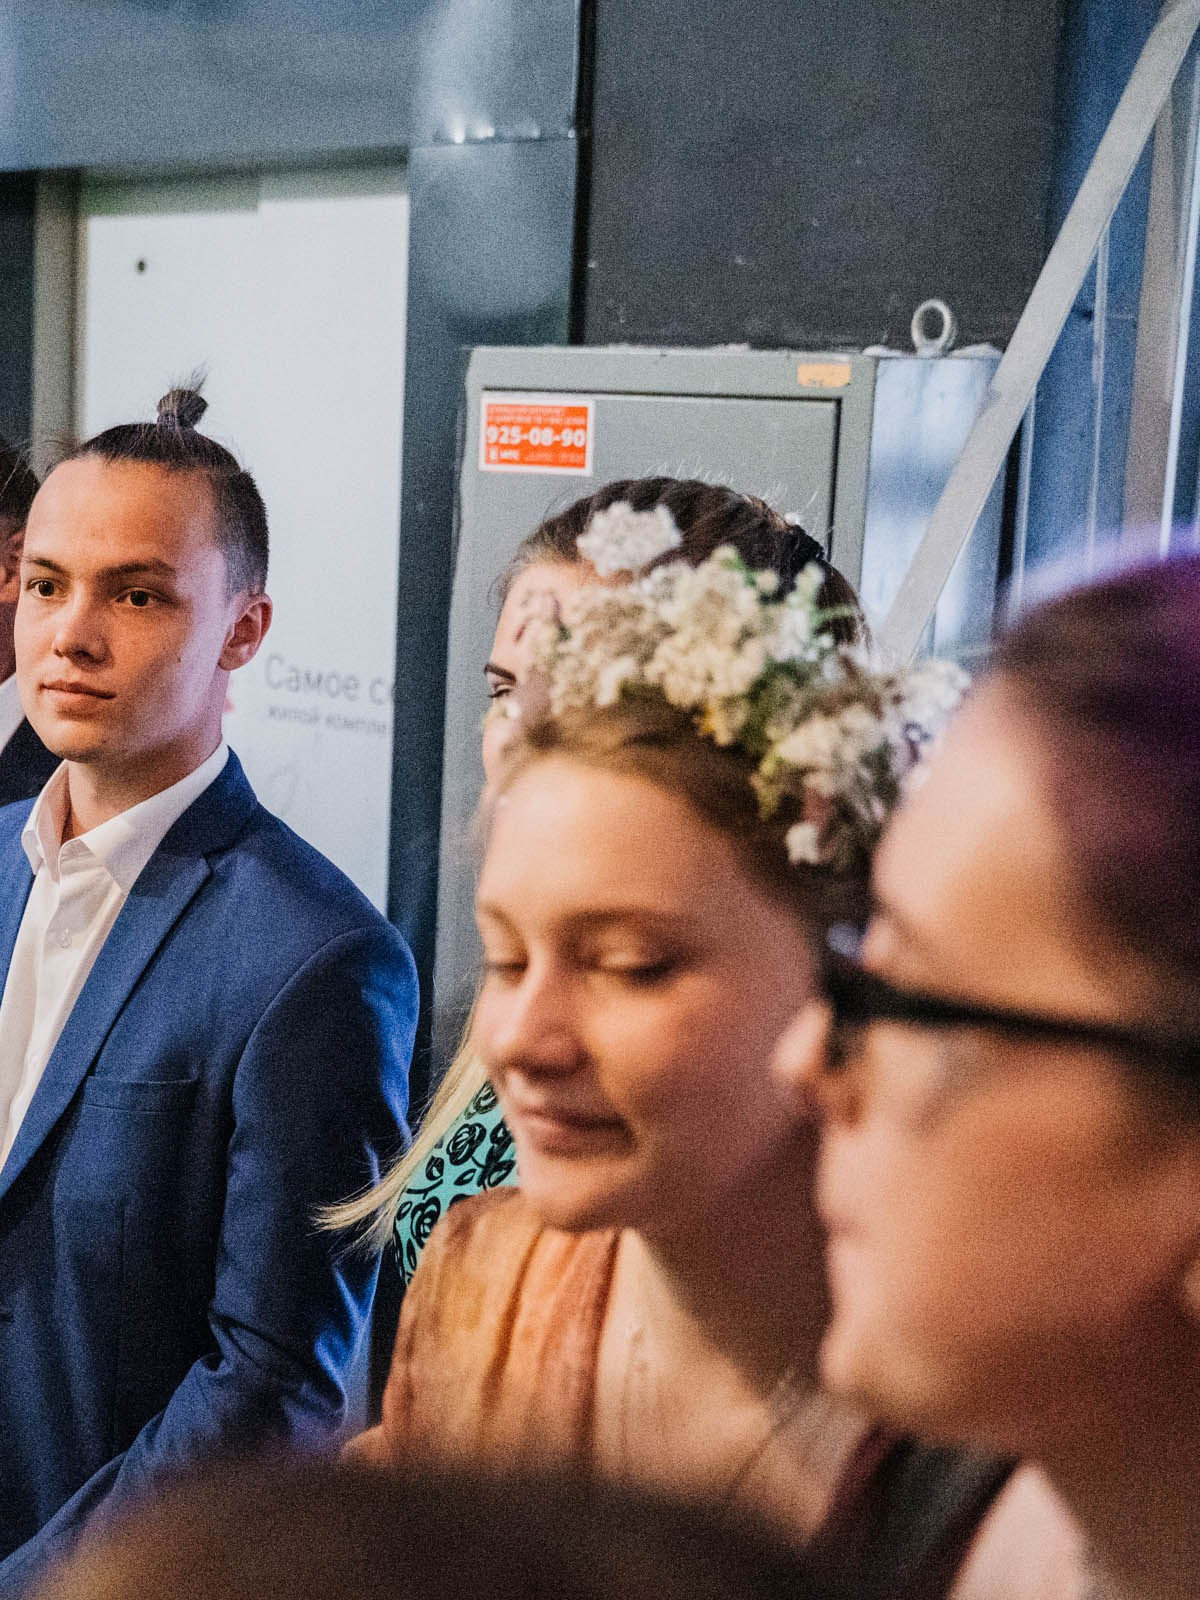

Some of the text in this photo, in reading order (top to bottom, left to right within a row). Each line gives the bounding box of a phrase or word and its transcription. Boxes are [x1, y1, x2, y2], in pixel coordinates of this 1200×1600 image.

[486, 425, 586, 448] 925-08-90
[265, 654, 392, 705] Самое с
